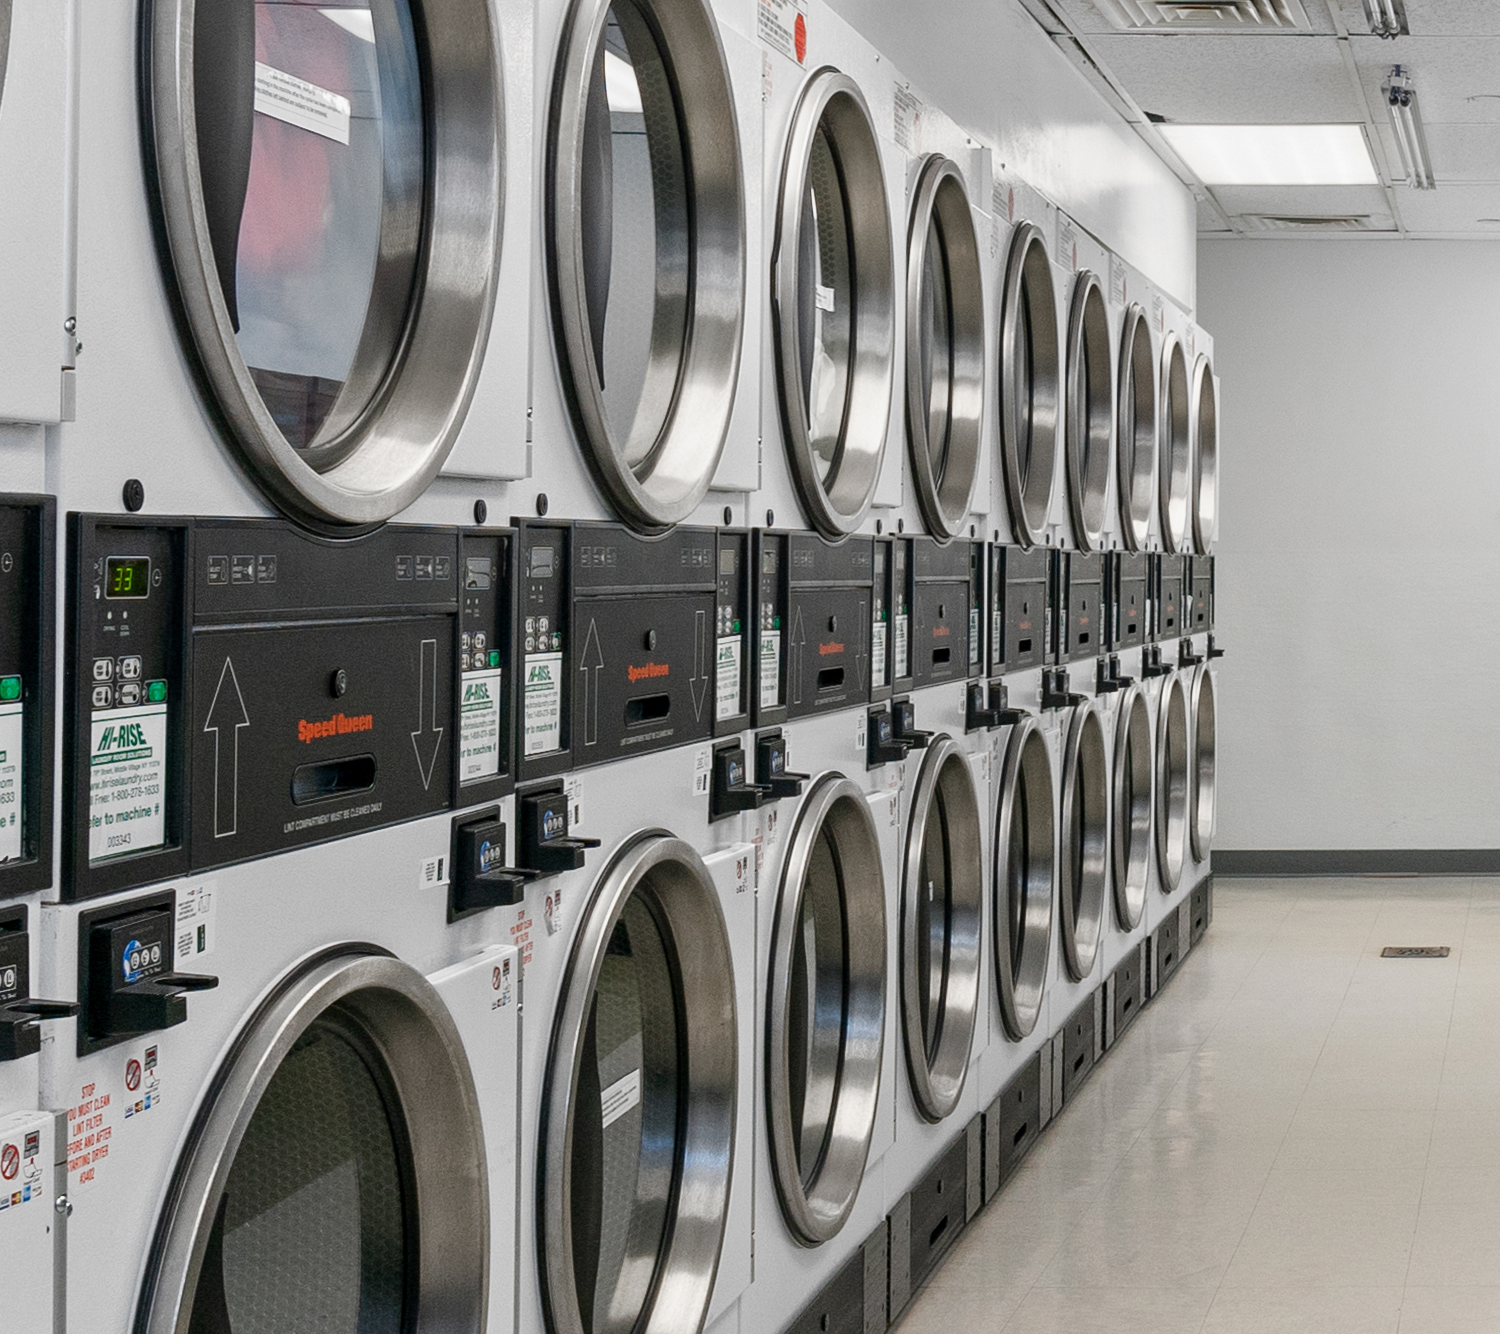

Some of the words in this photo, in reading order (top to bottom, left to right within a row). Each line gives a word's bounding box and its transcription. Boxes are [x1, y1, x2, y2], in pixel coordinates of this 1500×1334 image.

[114, 566, 134, 593] 33
[298, 715, 337, 744] Speed
[337, 712, 373, 735] Queen
